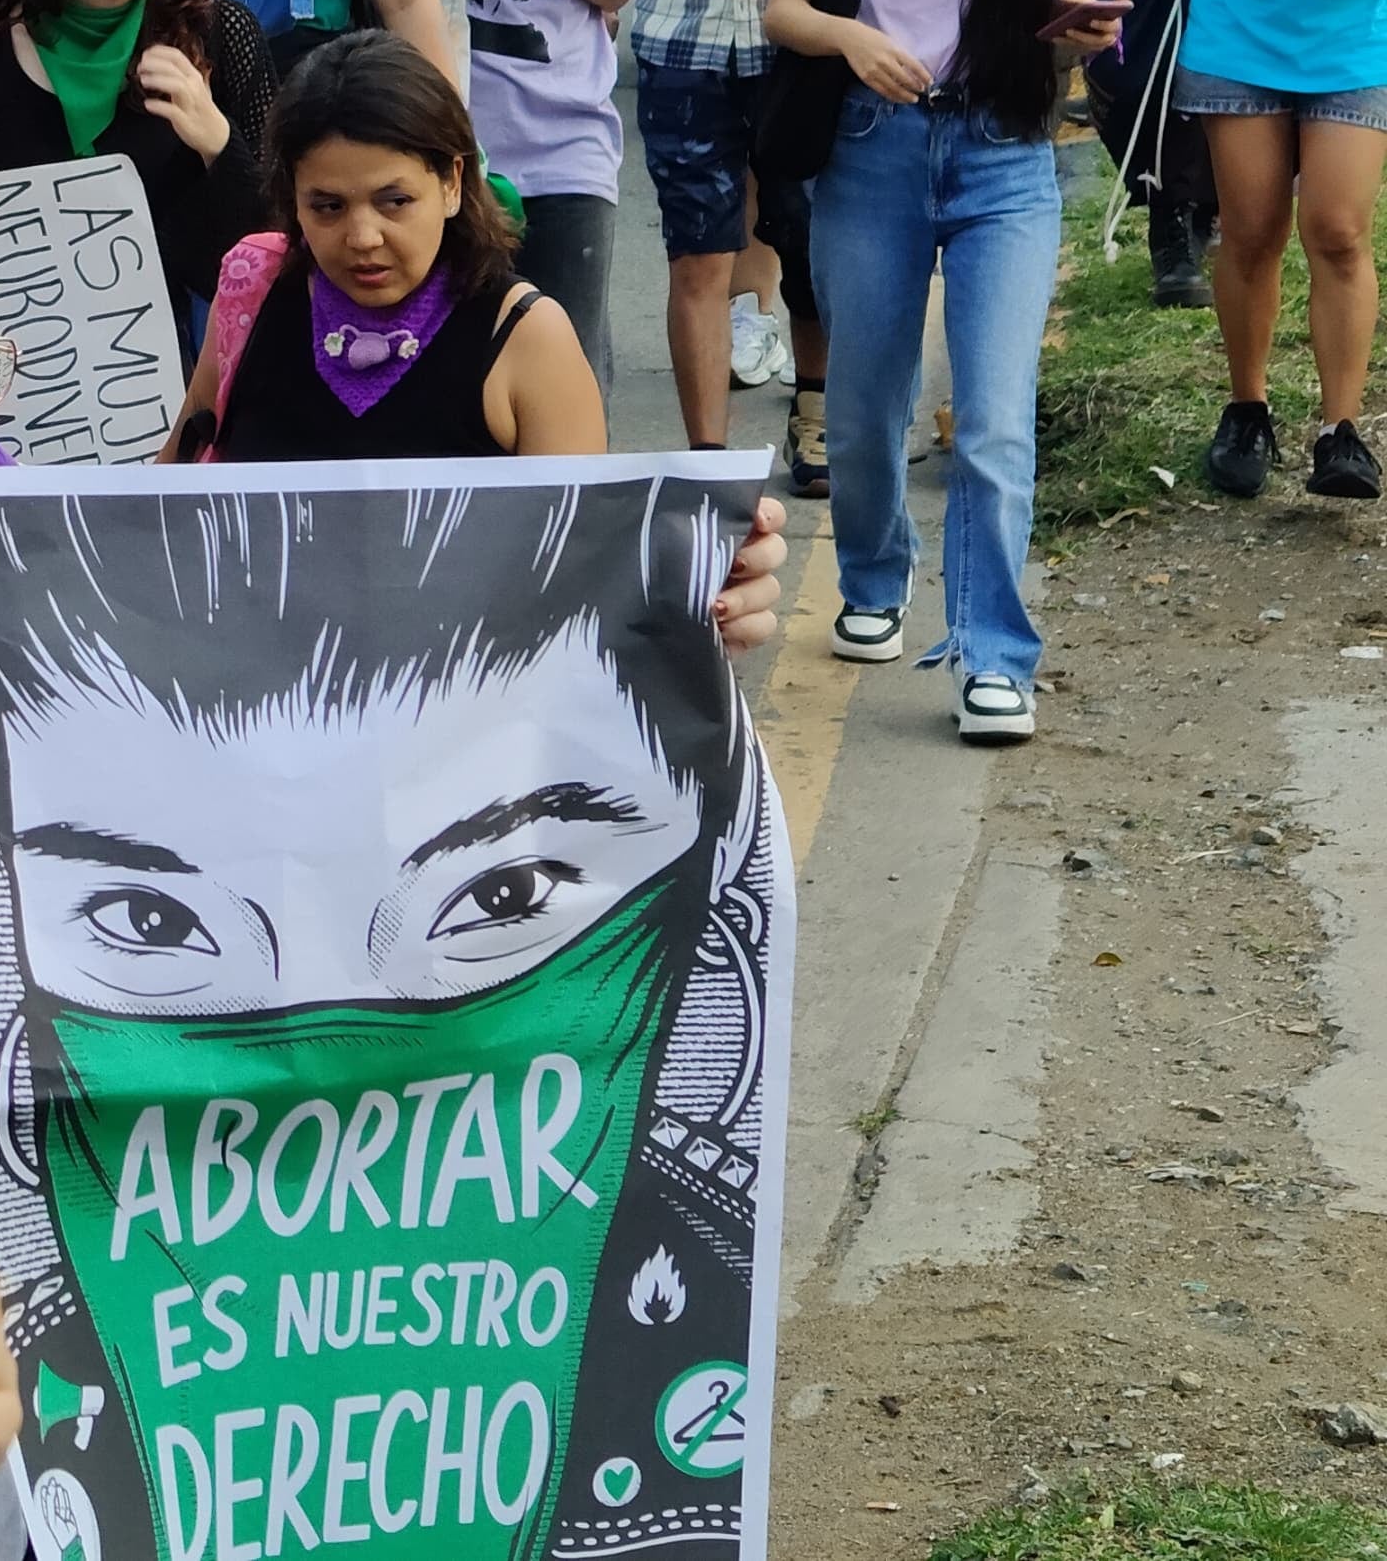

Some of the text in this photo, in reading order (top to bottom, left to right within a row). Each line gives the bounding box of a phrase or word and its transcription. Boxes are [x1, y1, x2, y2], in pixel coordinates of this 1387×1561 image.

[52, 163, 145, 292] LAS
[109, 1052, 598, 1261] ABORTAR
[153, 1257, 570, 1389] ES NUESTRO
[155, 1377, 552, 1561] DERECHO
